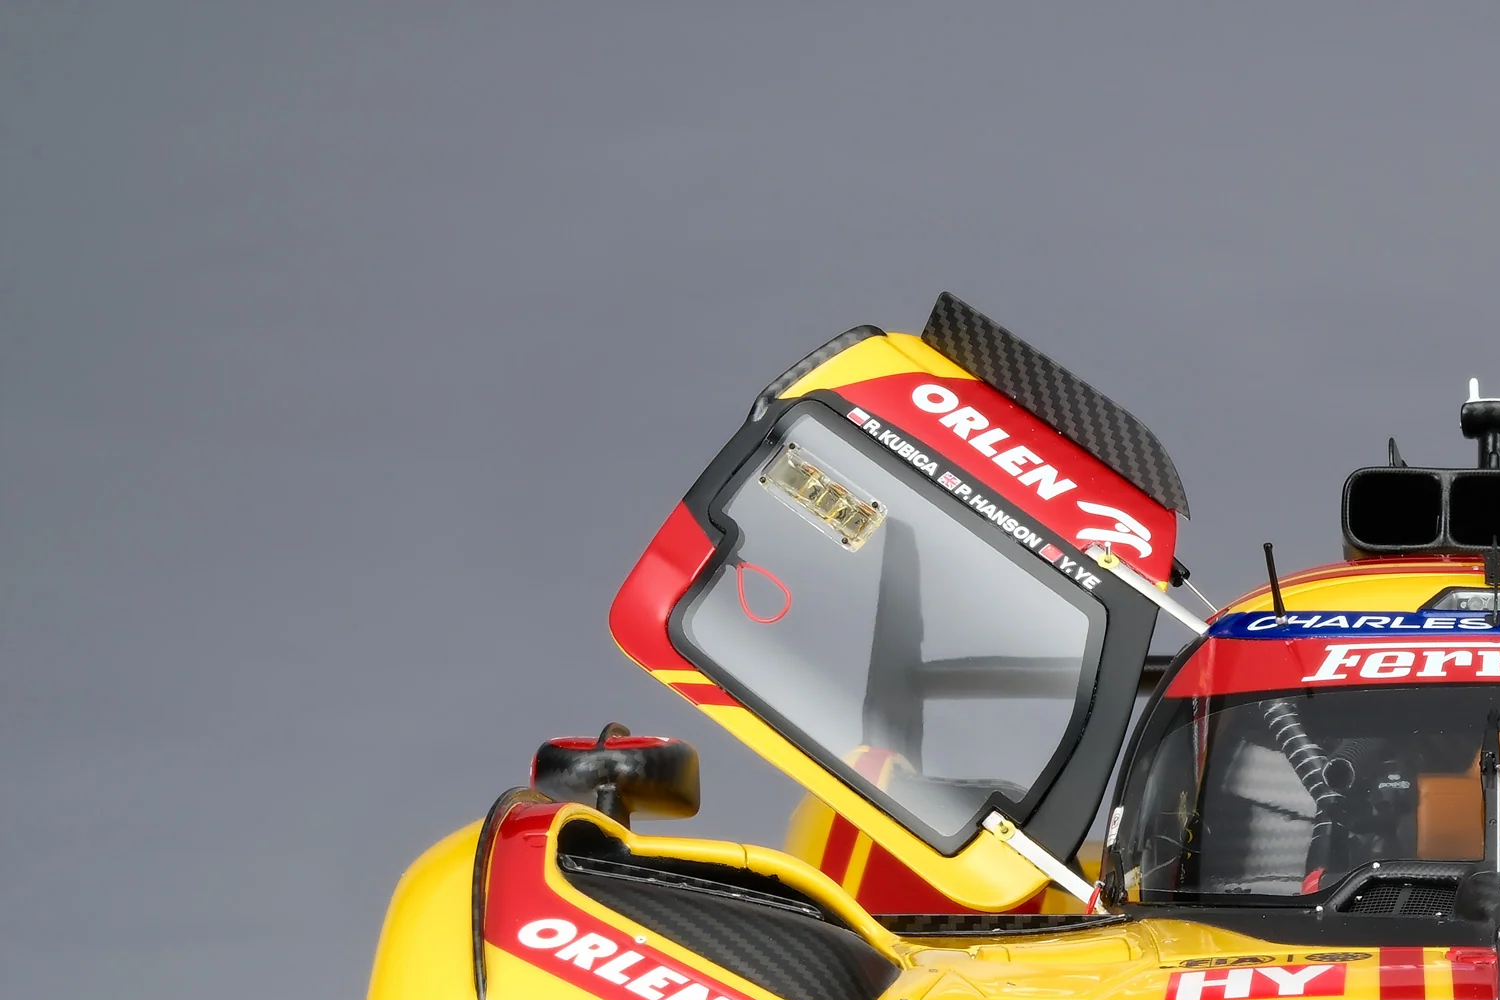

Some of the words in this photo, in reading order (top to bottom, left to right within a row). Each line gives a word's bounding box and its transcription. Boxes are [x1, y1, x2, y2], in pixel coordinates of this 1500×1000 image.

[911, 384, 1077, 500] ORLEN
[1247, 615, 1494, 630] CHARLES
[1185, 956, 1263, 968] FIA
